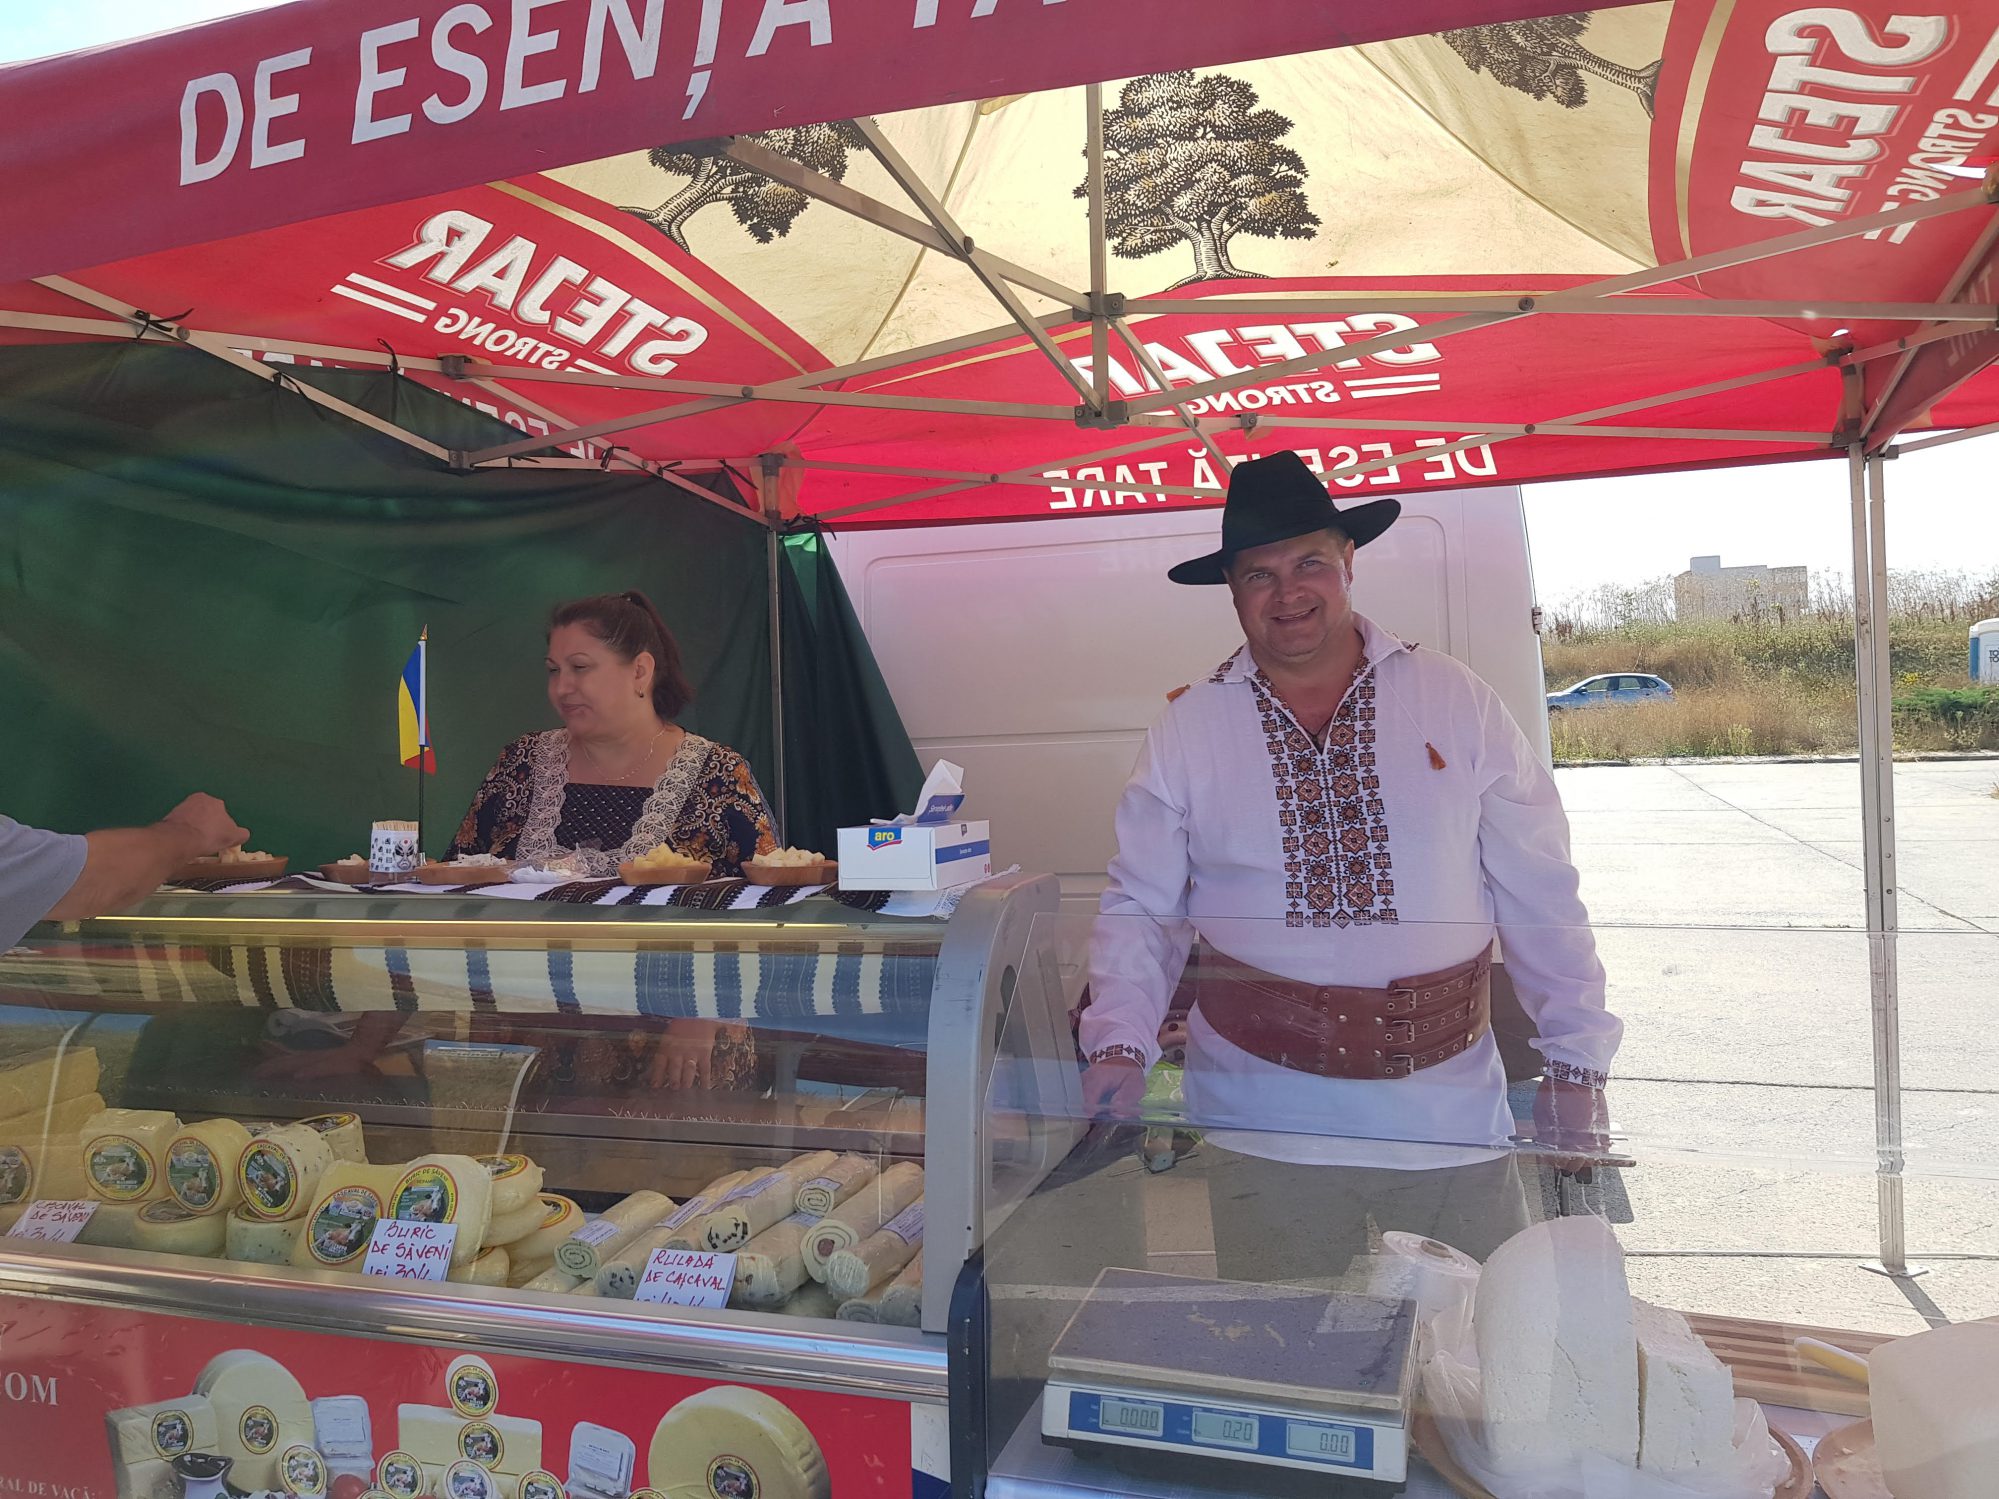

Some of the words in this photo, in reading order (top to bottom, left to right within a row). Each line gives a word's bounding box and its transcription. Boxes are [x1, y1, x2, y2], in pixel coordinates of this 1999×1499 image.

[180, 47, 313, 186] DE
[874, 831, 895, 842] aro
[30, 1210, 47, 1220] DE
[384, 1221, 437, 1240] BURIC
[371, 1241, 391, 1255] DE
[645, 1270, 664, 1284] DE
[0, 1371, 60, 1407] OM
[1119, 1406, 1160, 1430] 0.000
[1222, 1419, 1254, 1442] 0.20
[1318, 1431, 1350, 1455] 0.00
[28, 1480, 48, 1497] DE
